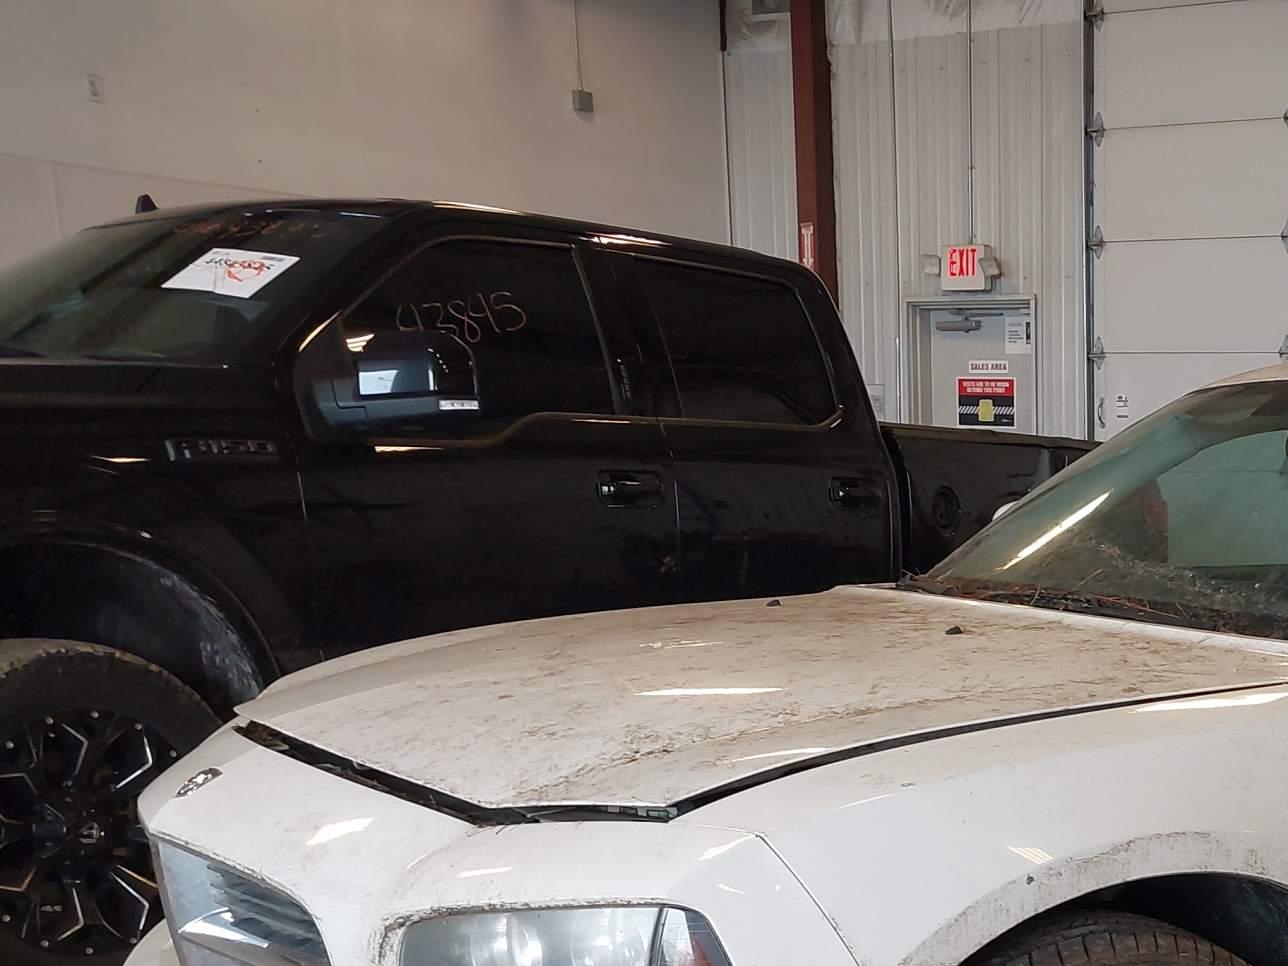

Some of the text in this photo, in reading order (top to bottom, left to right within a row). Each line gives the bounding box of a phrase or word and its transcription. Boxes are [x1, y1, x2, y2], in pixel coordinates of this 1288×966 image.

[949, 248, 977, 277] EXIT
[970, 363, 1008, 371] SALES AREA
